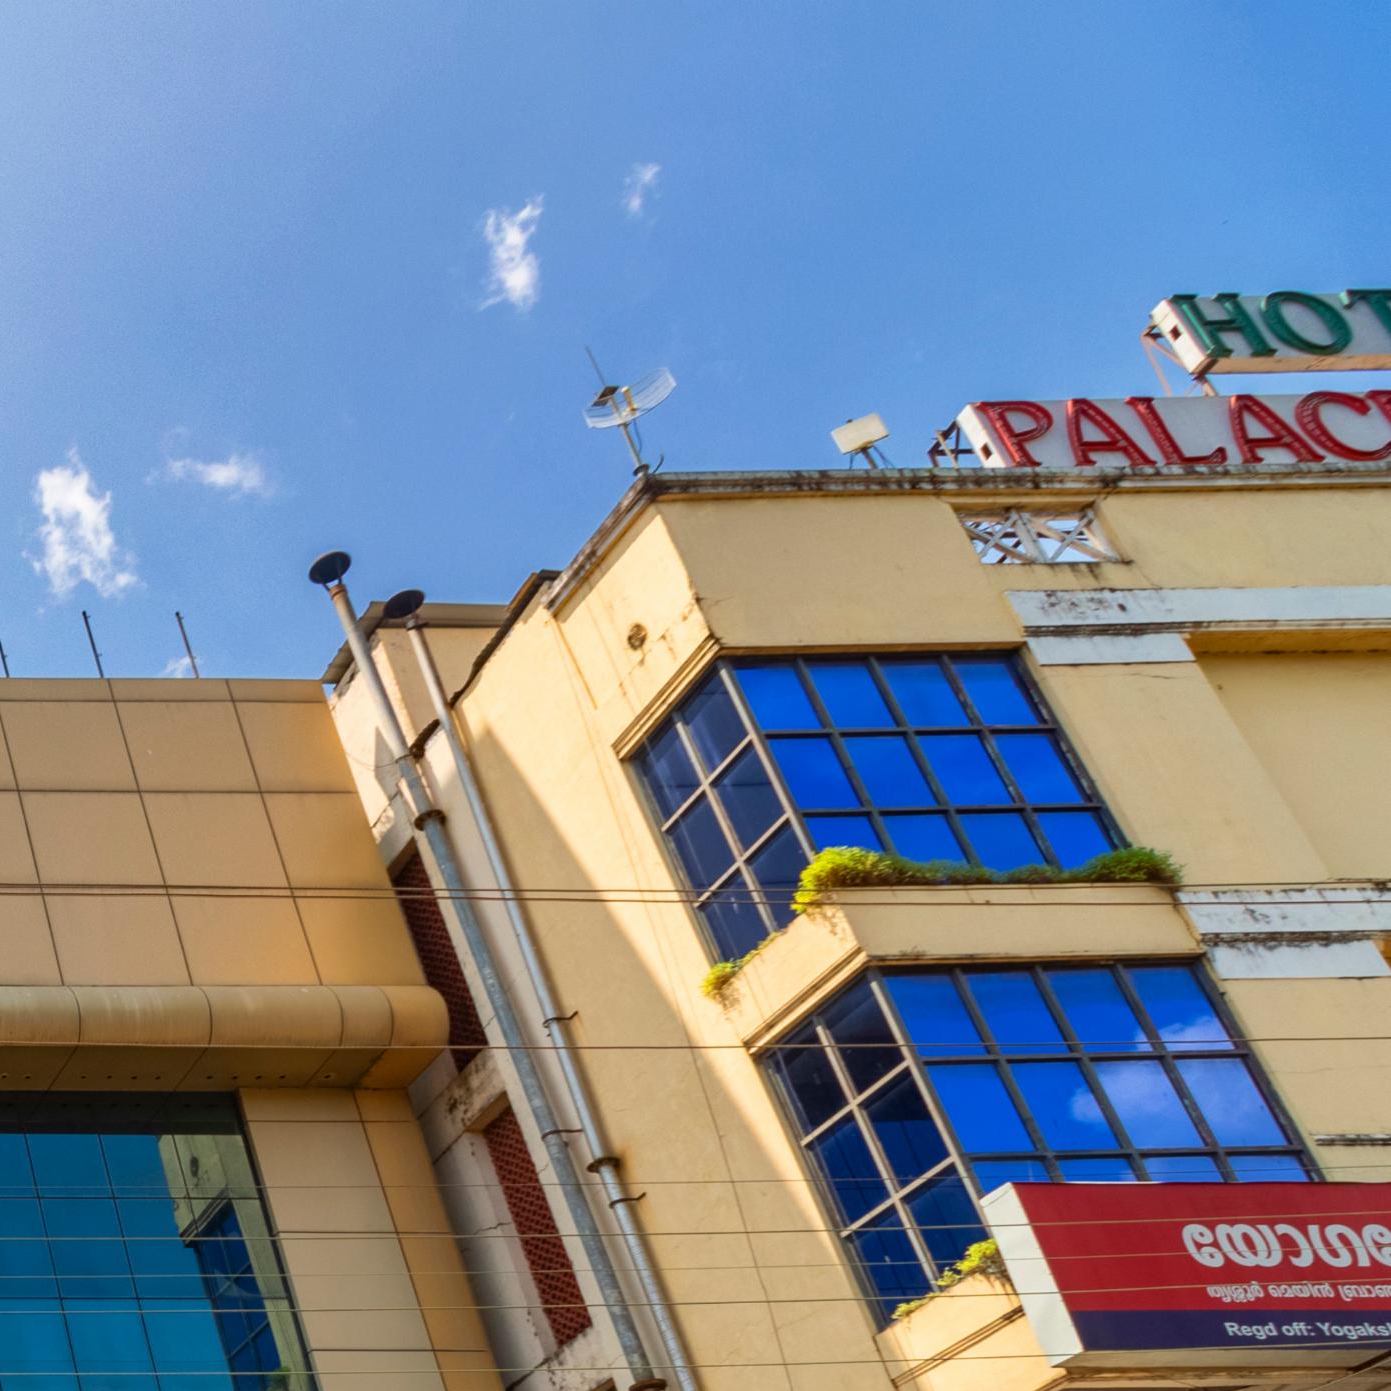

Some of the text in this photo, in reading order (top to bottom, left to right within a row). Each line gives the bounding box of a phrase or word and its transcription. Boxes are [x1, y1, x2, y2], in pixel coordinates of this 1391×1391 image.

[976, 390, 1391, 467] PALAC
[1224, 1322, 1278, 1340] Regd
[1281, 1322, 1315, 1336] off:
